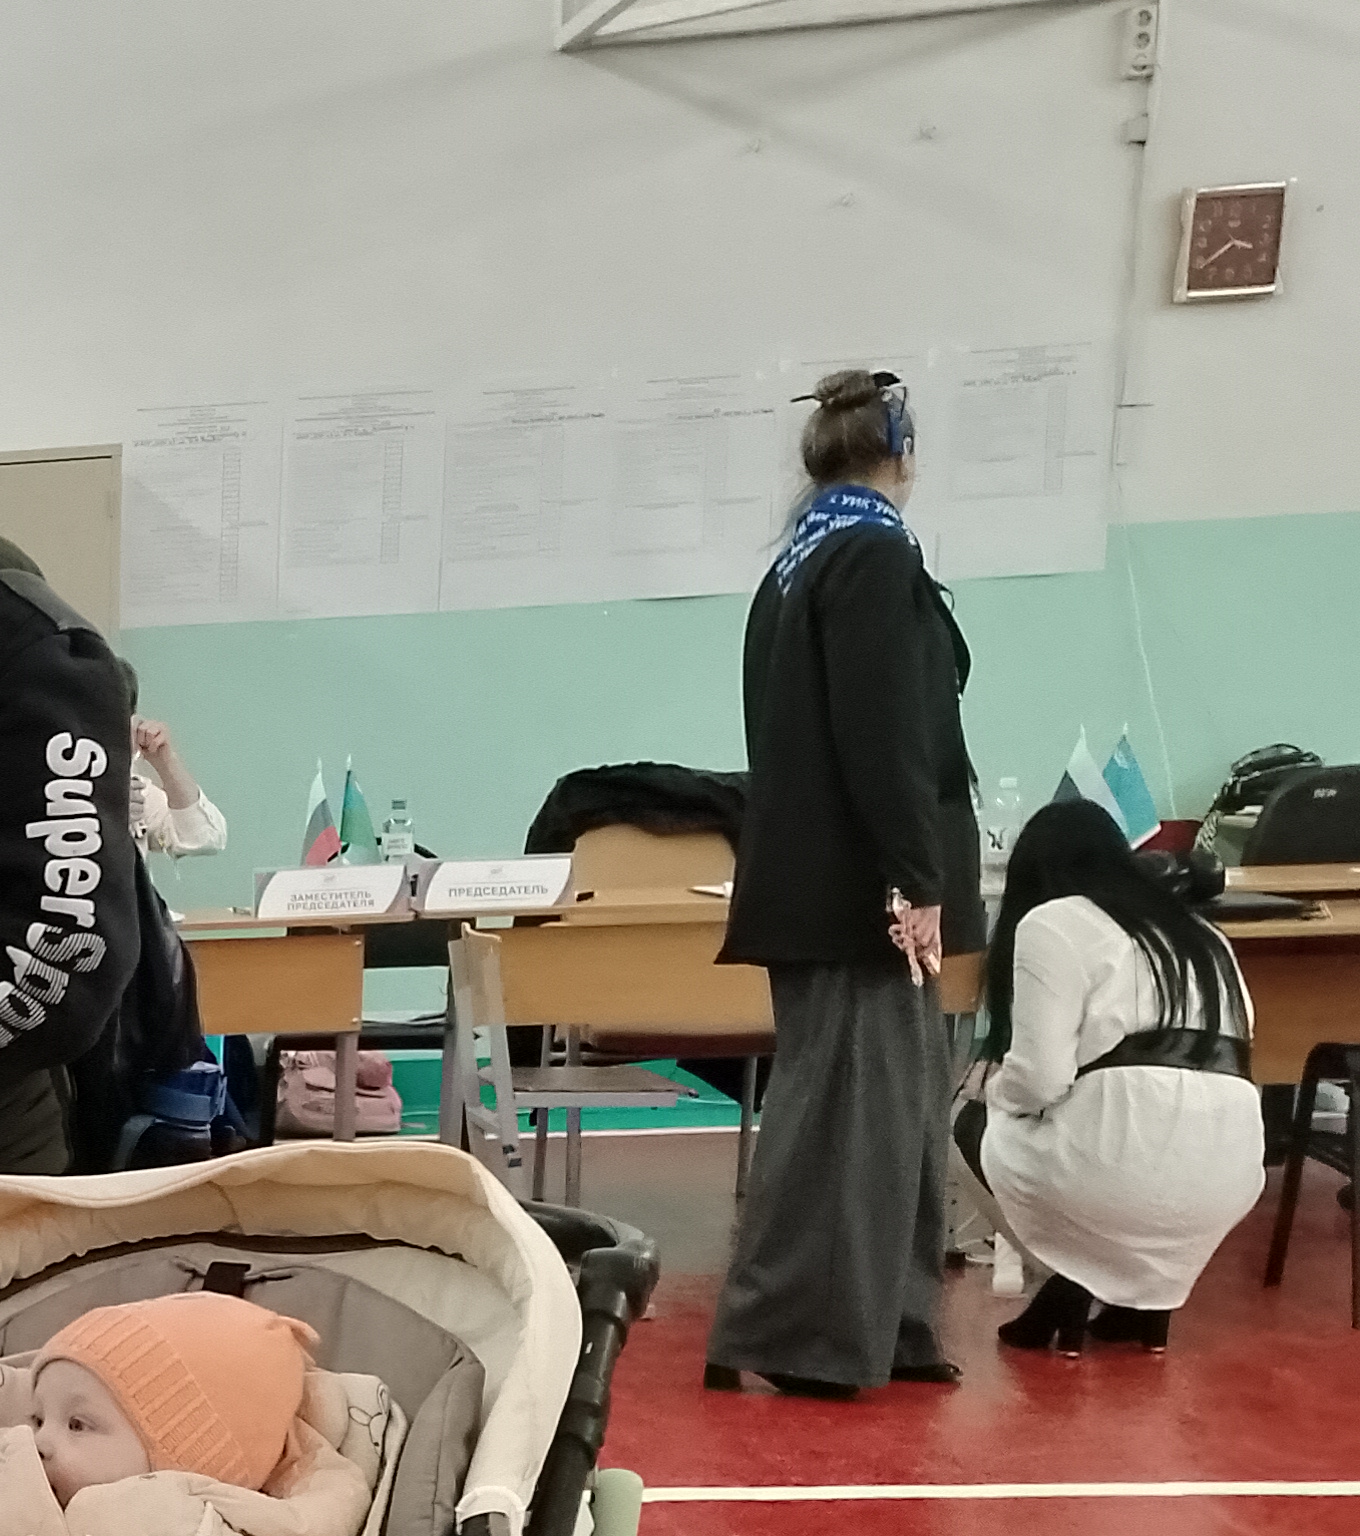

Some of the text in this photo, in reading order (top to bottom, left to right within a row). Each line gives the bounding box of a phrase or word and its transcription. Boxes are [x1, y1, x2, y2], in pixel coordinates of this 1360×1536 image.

[290, 890, 372, 903] ЗАМЕСТИТЕЛЬ
[448, 884, 548, 898] ПРЕДСЕДАТЕЛЬ
[287, 899, 375, 911] ПРЕДСЕДАТЕЛЯ
